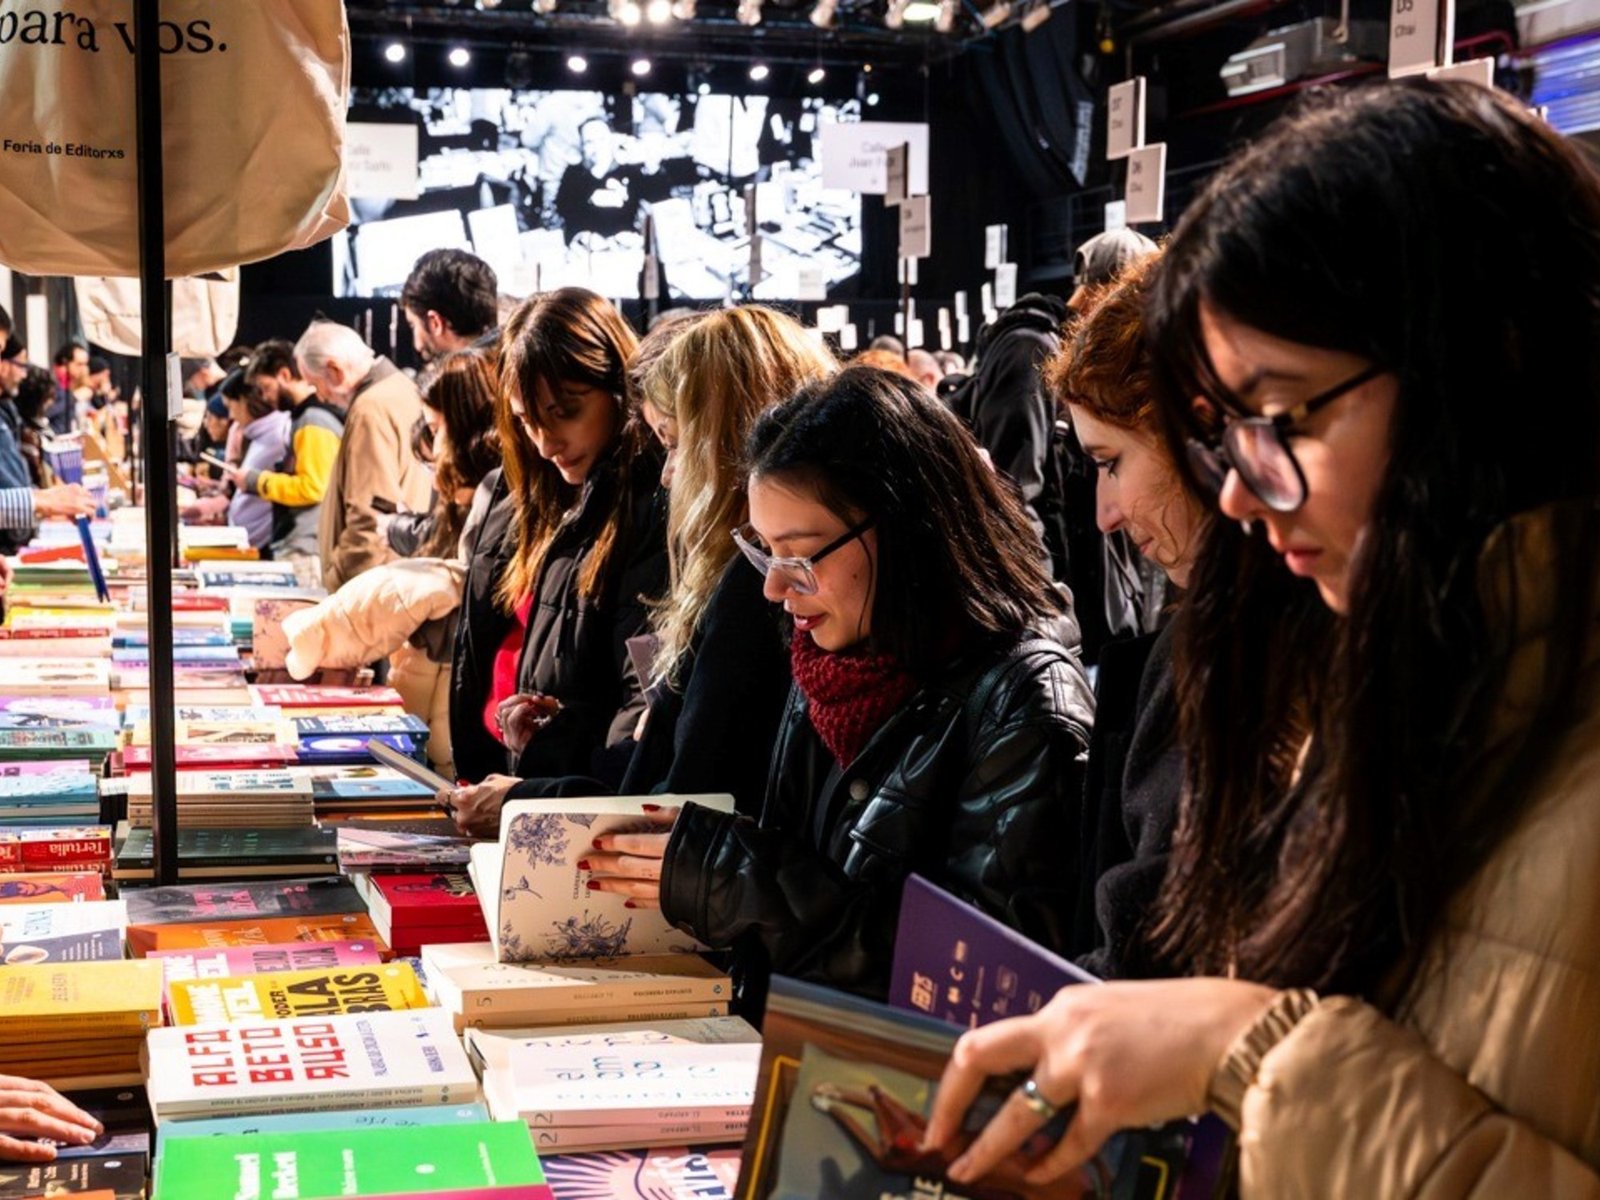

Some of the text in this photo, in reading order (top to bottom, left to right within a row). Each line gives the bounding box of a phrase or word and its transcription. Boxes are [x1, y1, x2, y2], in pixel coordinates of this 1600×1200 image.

[3, 139, 125, 160] Feria de Editorxs
[49, 842, 106, 856] Tertulia
[269, 989, 292, 1019] ODER
[287, 975, 343, 1017] ALA
[185, 1029, 238, 1087] ALFA
[239, 1027, 294, 1083] BETO
